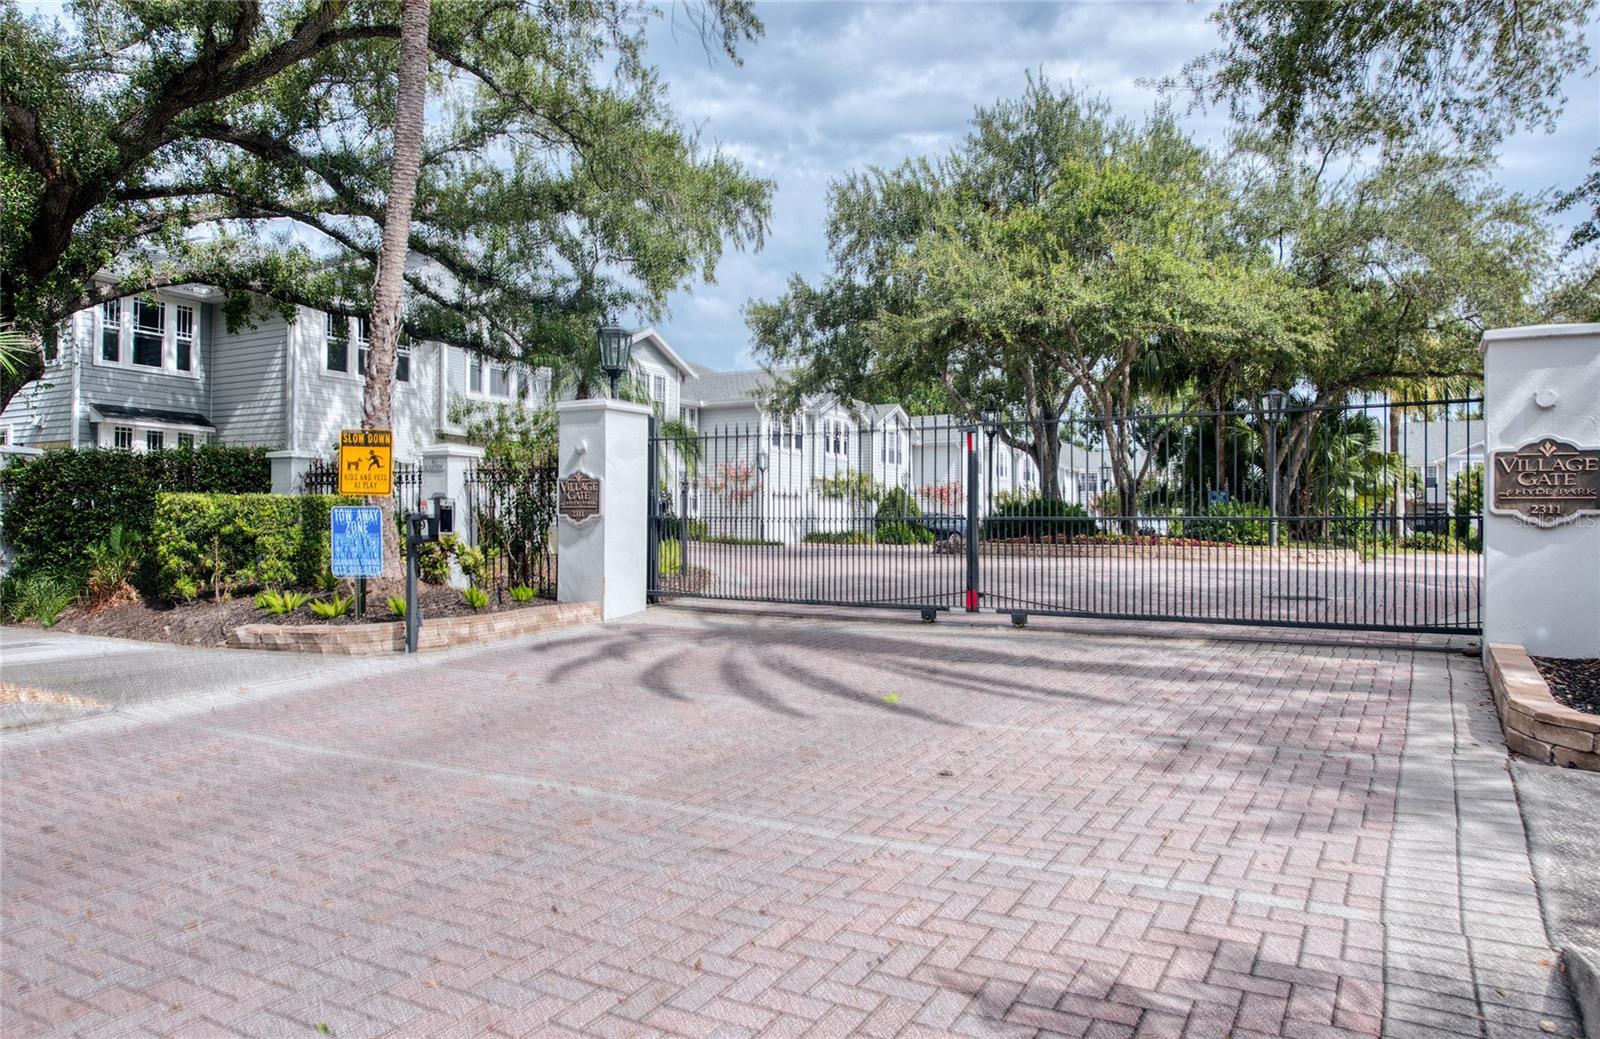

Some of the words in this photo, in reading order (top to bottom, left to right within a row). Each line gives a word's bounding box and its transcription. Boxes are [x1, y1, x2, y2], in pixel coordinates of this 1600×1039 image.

[343, 433, 364, 443] SLOW
[368, 433, 390, 443] DOWN
[1497, 456, 1599, 473] VILLAGE
[1517, 471, 1577, 486] GATE
[560, 481, 598, 492] VILLAGE
[567, 491, 591, 500] GATE
[1499, 489, 1513, 497] of
[1559, 488, 1597, 496] PARK
[1531, 504, 1561, 514] 2311
[333, 509, 351, 522] TOW
[356, 509, 379, 522] AWAY
[346, 521, 368, 534] ZONE
